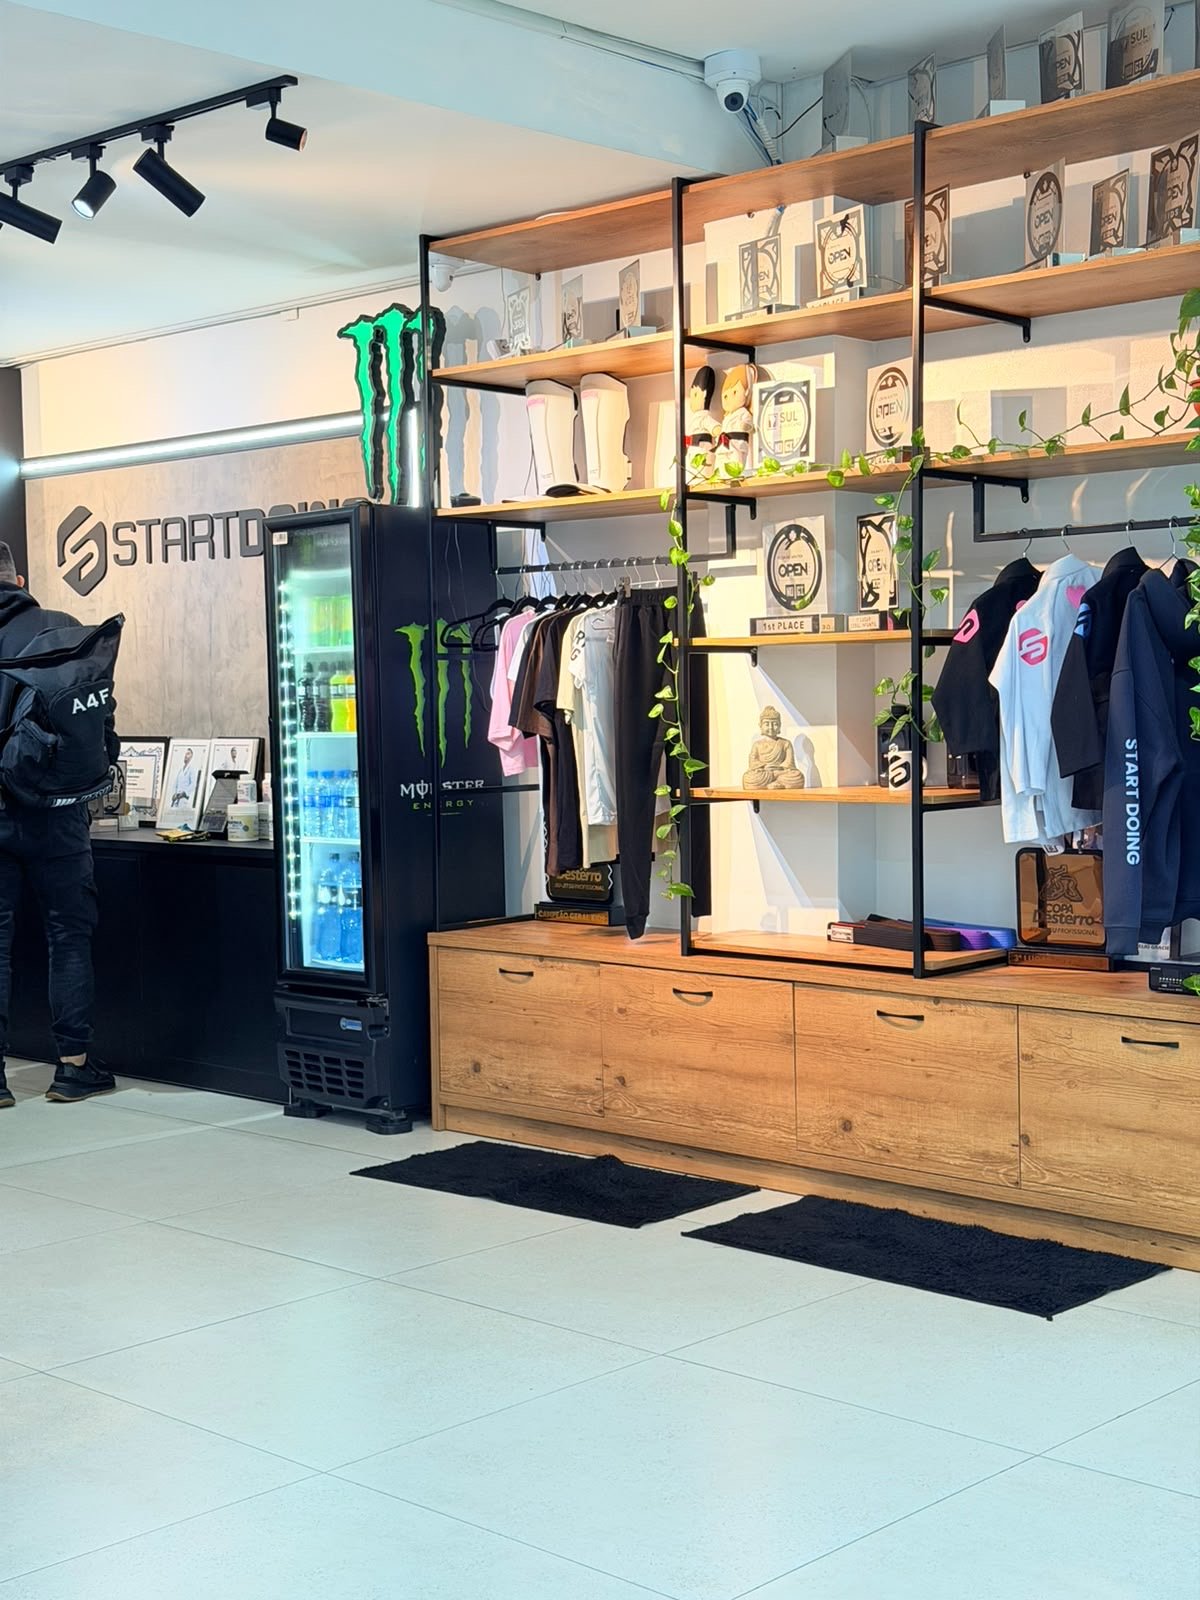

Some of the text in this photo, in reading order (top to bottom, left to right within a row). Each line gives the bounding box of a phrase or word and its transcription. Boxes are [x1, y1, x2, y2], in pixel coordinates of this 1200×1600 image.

[1130, 28, 1148, 45] SUL
[828, 247, 851, 265] OPEN
[779, 410, 798, 423] SUL
[875, 399, 903, 419] OPEN
[778, 562, 808, 578] OPEN
[867, 557, 887, 573] OPEN
[763, 620, 805, 632] 1st PLACE
[72, 687, 109, 715] A4F
[412, 799, 475, 810] ENRGY
[1125, 738, 1140, 866] START DOING
[1045, 903, 1074, 914] COPA
